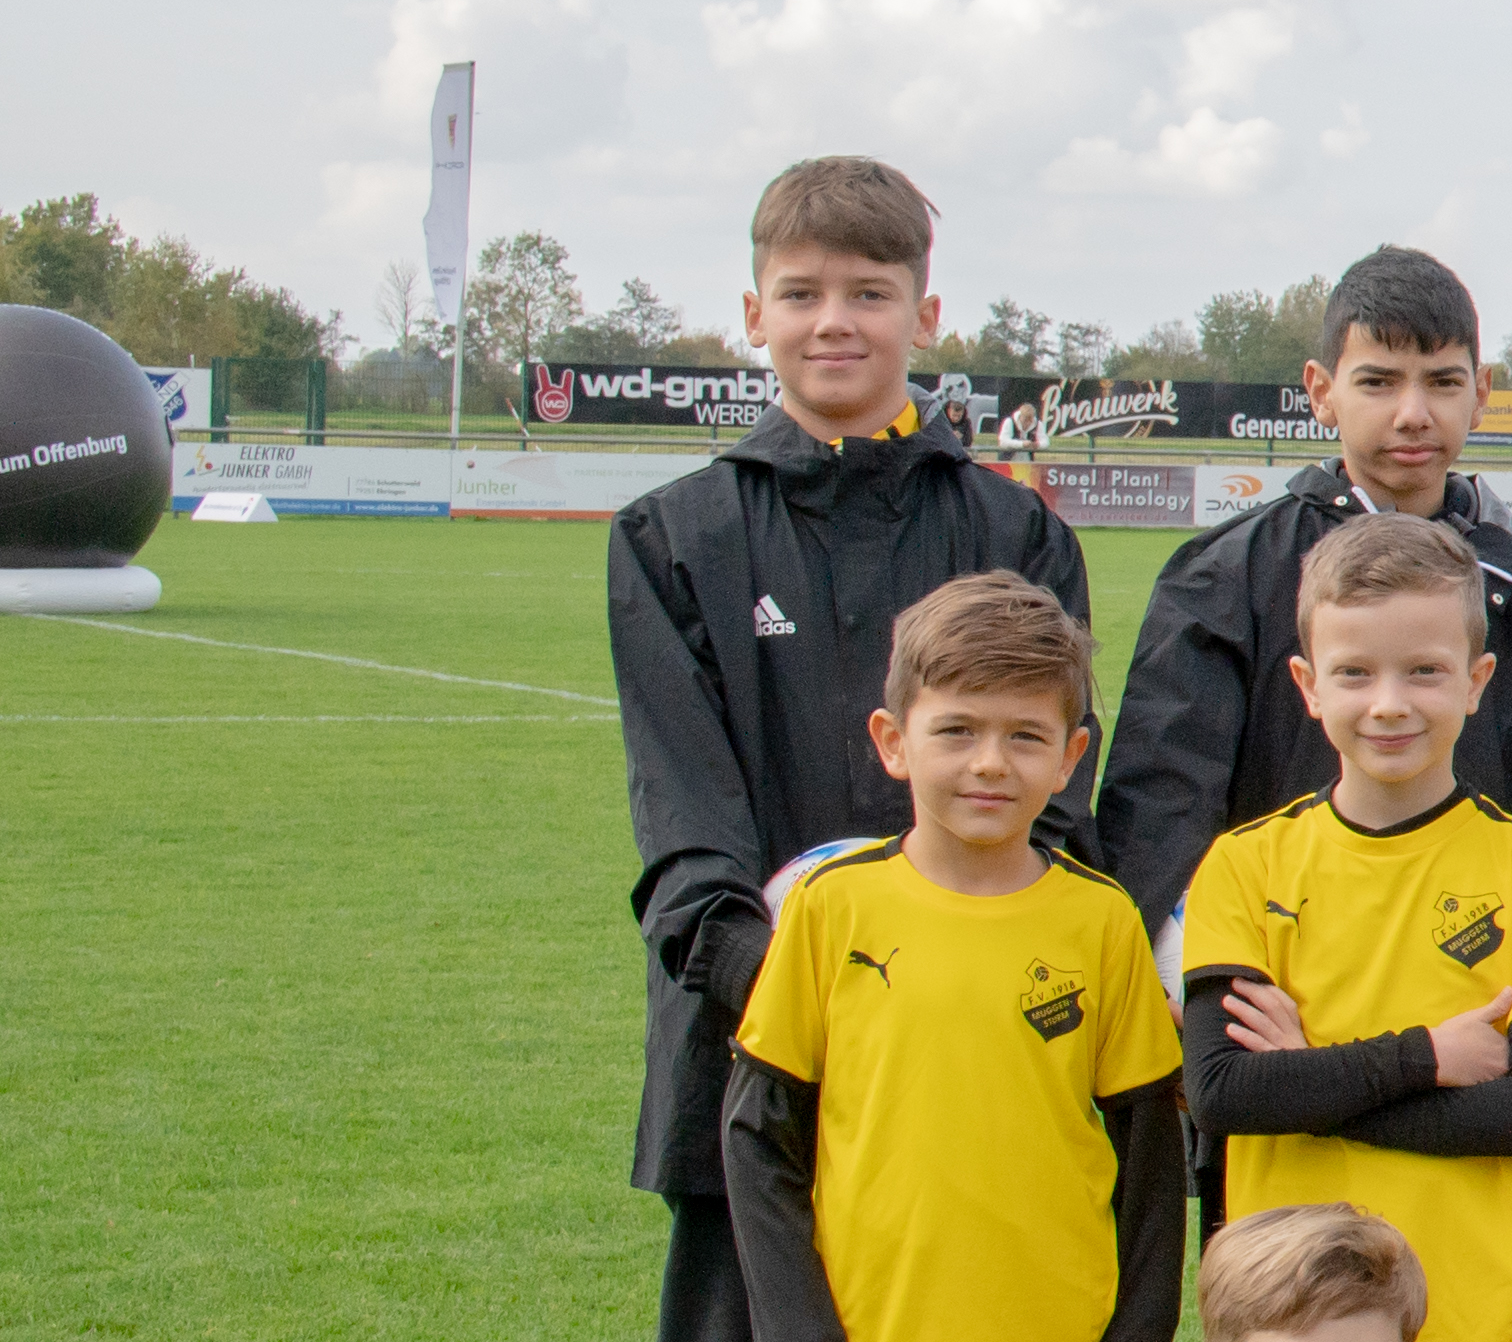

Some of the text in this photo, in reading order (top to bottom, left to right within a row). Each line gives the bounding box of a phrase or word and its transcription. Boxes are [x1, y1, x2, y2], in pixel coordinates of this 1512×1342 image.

[1041, 380, 1180, 436] Brauwerk
[1281, 387, 1309, 412] Die
[1230, 413, 1342, 442] Generatio
[34, 434, 128, 467] Offenburg
[240, 446, 296, 461] ELEKTRO
[219, 464, 313, 480] JUNKER GMBH
[1047, 468, 1160, 487] Steel Plant
[456, 478, 517, 496] Junker
[1079, 488, 1191, 512] Technology
[1463, 902, 1490, 921] 1918
[1461, 932, 1490, 957] STURM
[1051, 979, 1076, 996] 1918
